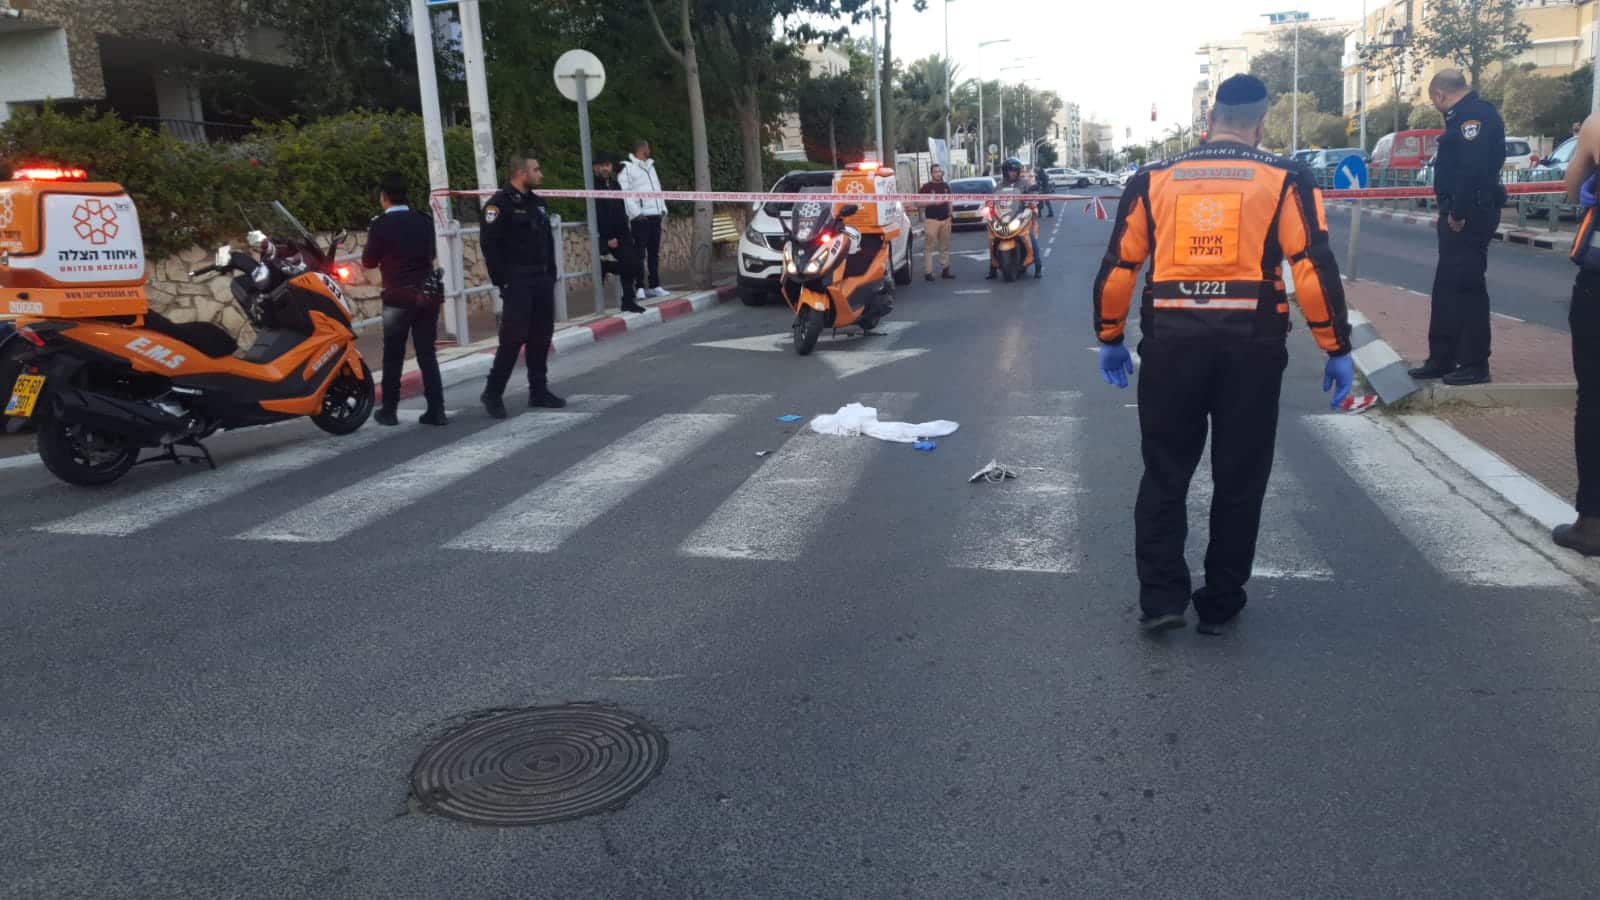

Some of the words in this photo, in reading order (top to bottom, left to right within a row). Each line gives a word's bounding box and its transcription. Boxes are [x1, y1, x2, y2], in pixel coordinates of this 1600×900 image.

[1190, 236, 1223, 245] איחוד
[58, 249, 98, 261] הצלה
[102, 249, 137, 260] איחוד
[1189, 246, 1223, 256] הצלה
[1194, 281, 1227, 295] 1221
